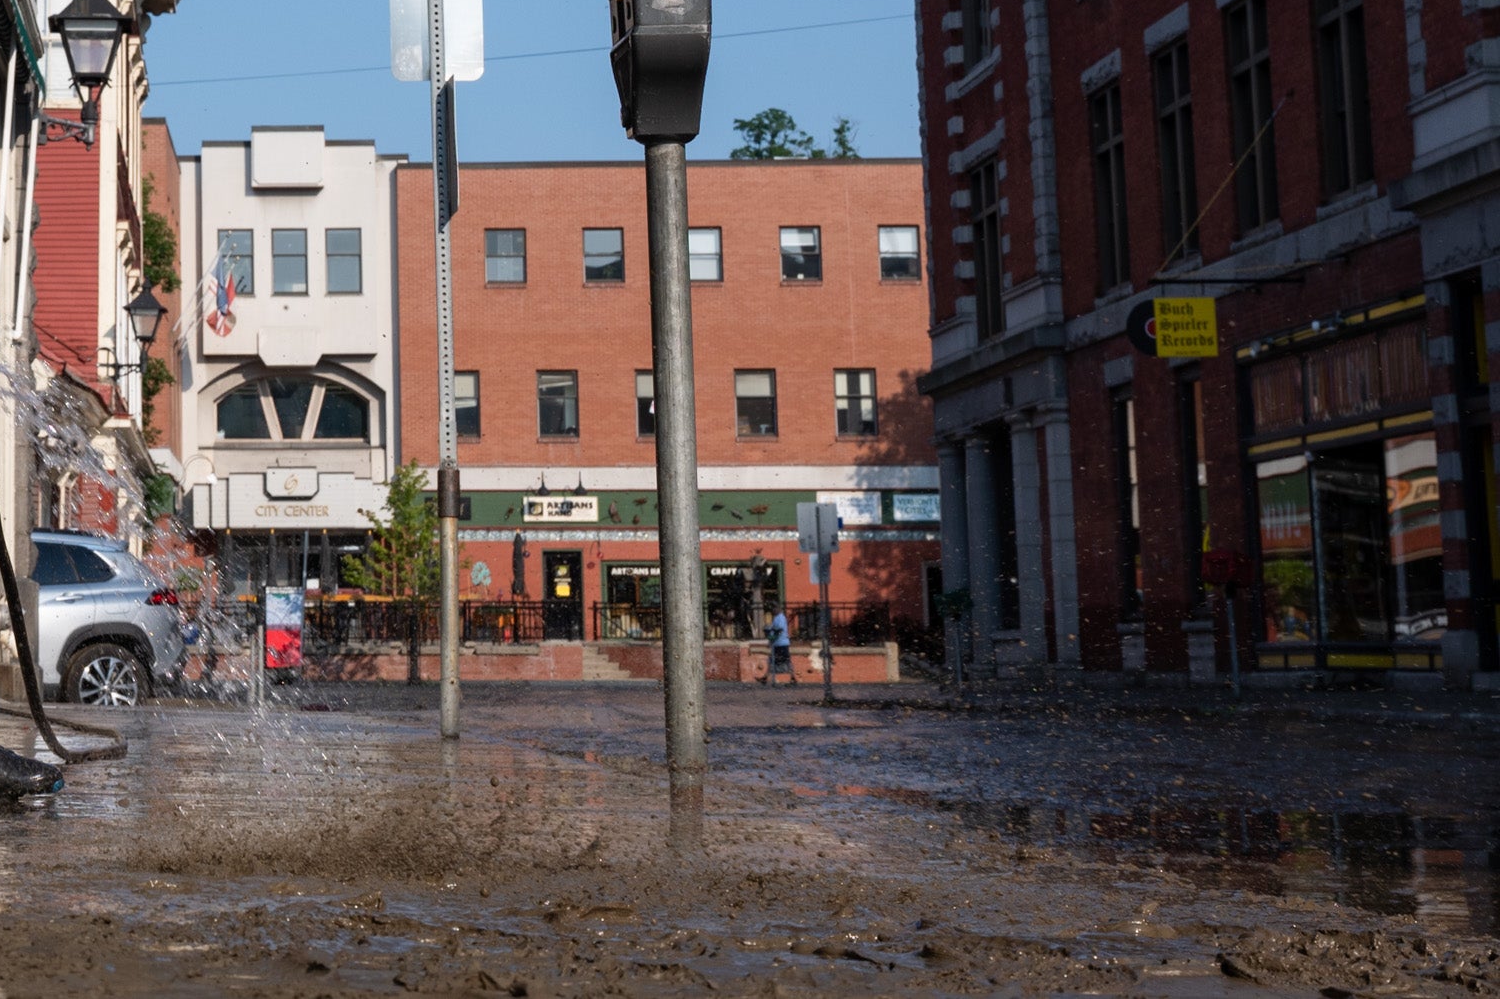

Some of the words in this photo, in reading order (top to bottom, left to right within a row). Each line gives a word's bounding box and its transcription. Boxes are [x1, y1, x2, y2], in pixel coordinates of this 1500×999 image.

[1158, 302, 1194, 316] Buch
[1159, 318, 1208, 332] Spieler
[1160, 333, 1215, 347] Records
[255, 505, 279, 517] CITY
[284, 505, 329, 517] CENTER
[611, 567, 649, 576] ARTANS
[710, 567, 738, 577] CRAFT
